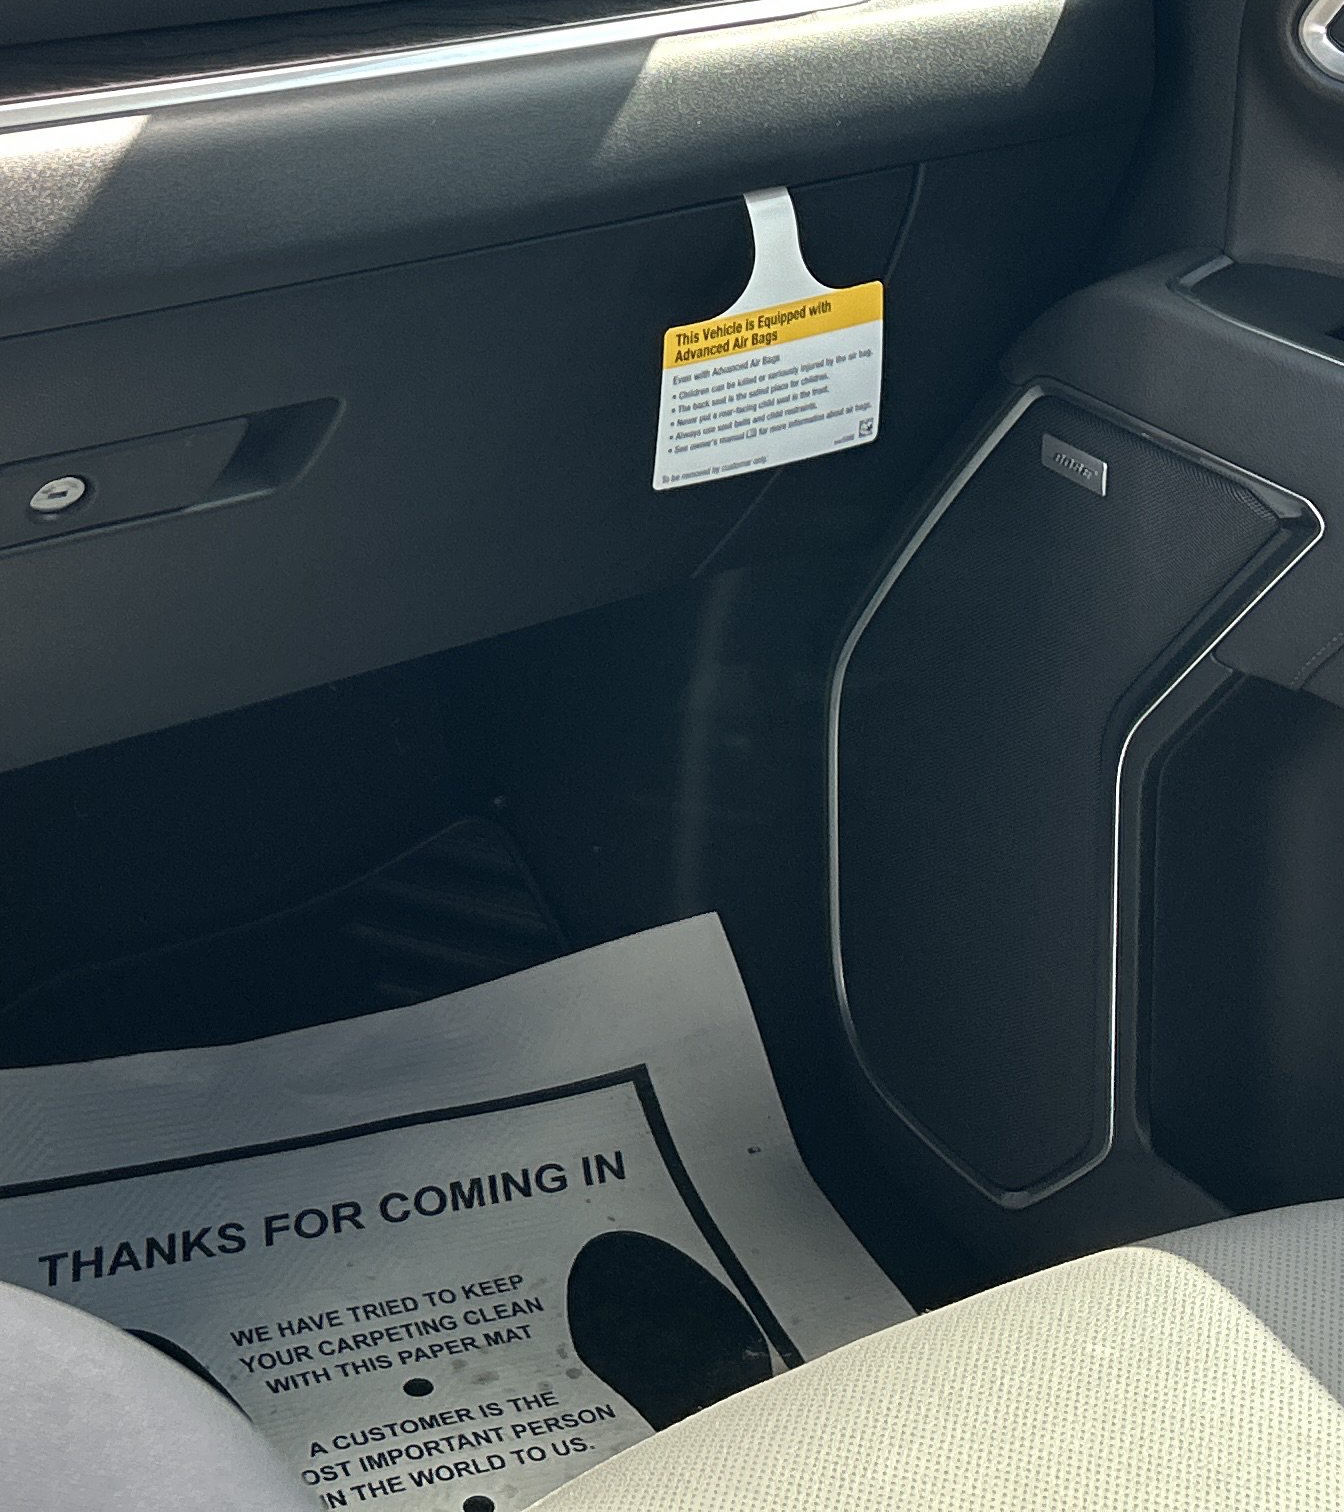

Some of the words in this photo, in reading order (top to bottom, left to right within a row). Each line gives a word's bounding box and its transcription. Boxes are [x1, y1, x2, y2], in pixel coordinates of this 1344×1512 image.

[674, 338, 730, 363] Advanced
[732, 336, 749, 351] Air
[751, 330, 778, 346] Bags
[675, 330, 700, 347] This
[702, 321, 743, 341] Vehicle
[745, 318, 755, 332] is
[757, 304, 806, 329] Equipped
[808, 300, 832, 317] with
[678, 386, 710, 400] Children
[711, 384, 725, 393] can
[726, 381, 736, 390] be
[737, 375, 757, 387] killed
[758, 374, 766, 383] or
[835, 354, 847, 364] the
[847, 352, 858, 361] air
[693, 370, 711, 380] with
[711, 360, 749, 377] Advanced
[749, 357, 761, 368] Air
[678, 404, 691, 413] The
[727, 394, 735, 403] is
[736, 392, 747, 401] the
[790, 380, 799, 388] for
[698, 413, 712, 424] put
[791, 393, 799, 401] in
[799, 390, 811, 399] the
[674, 429, 702, 441] Always
[752, 414, 766, 424] and
[758, 427, 769, 435] for
[671, 474, 681, 483] be
[38, 1221, 247, 1287] THANKS
[263, 1200, 365, 1247] FOR
[379, 1163, 569, 1223] COMING
[581, 1150, 627, 1186] IN
[230, 1326, 272, 1347] WE
[276, 1309, 344, 1338] HAVE
[346, 1296, 419, 1324] TRIED
[423, 1288, 457, 1308] TO
[461, 1274, 524, 1300] KEEP
[239, 1344, 313, 1374] YOUR
[317, 1315, 458, 1357] CARPETING
[463, 1296, 544, 1326] CLEAN
[265, 1367, 331, 1394] WITH
[335, 1355, 393, 1379] THIS
[398, 1335, 481, 1366] PAPER
[482, 1324, 534, 1347] MAT
[301, 1461, 352, 1485] OST
[359, 1428, 505, 1473] IMPORTANT
[513, 1404, 617, 1440] PERSON
[309, 1441, 329, 1458] A
[332, 1407, 473, 1451] CUSTOMER
[479, 1402, 504, 1418] IS
[506, 1391, 559, 1412] THE
[349, 1477, 406, 1503] THE
[408, 1455, 506, 1489] WORLD
[510, 1445, 547, 1466] TO
[551, 1437, 596, 1457] US.
